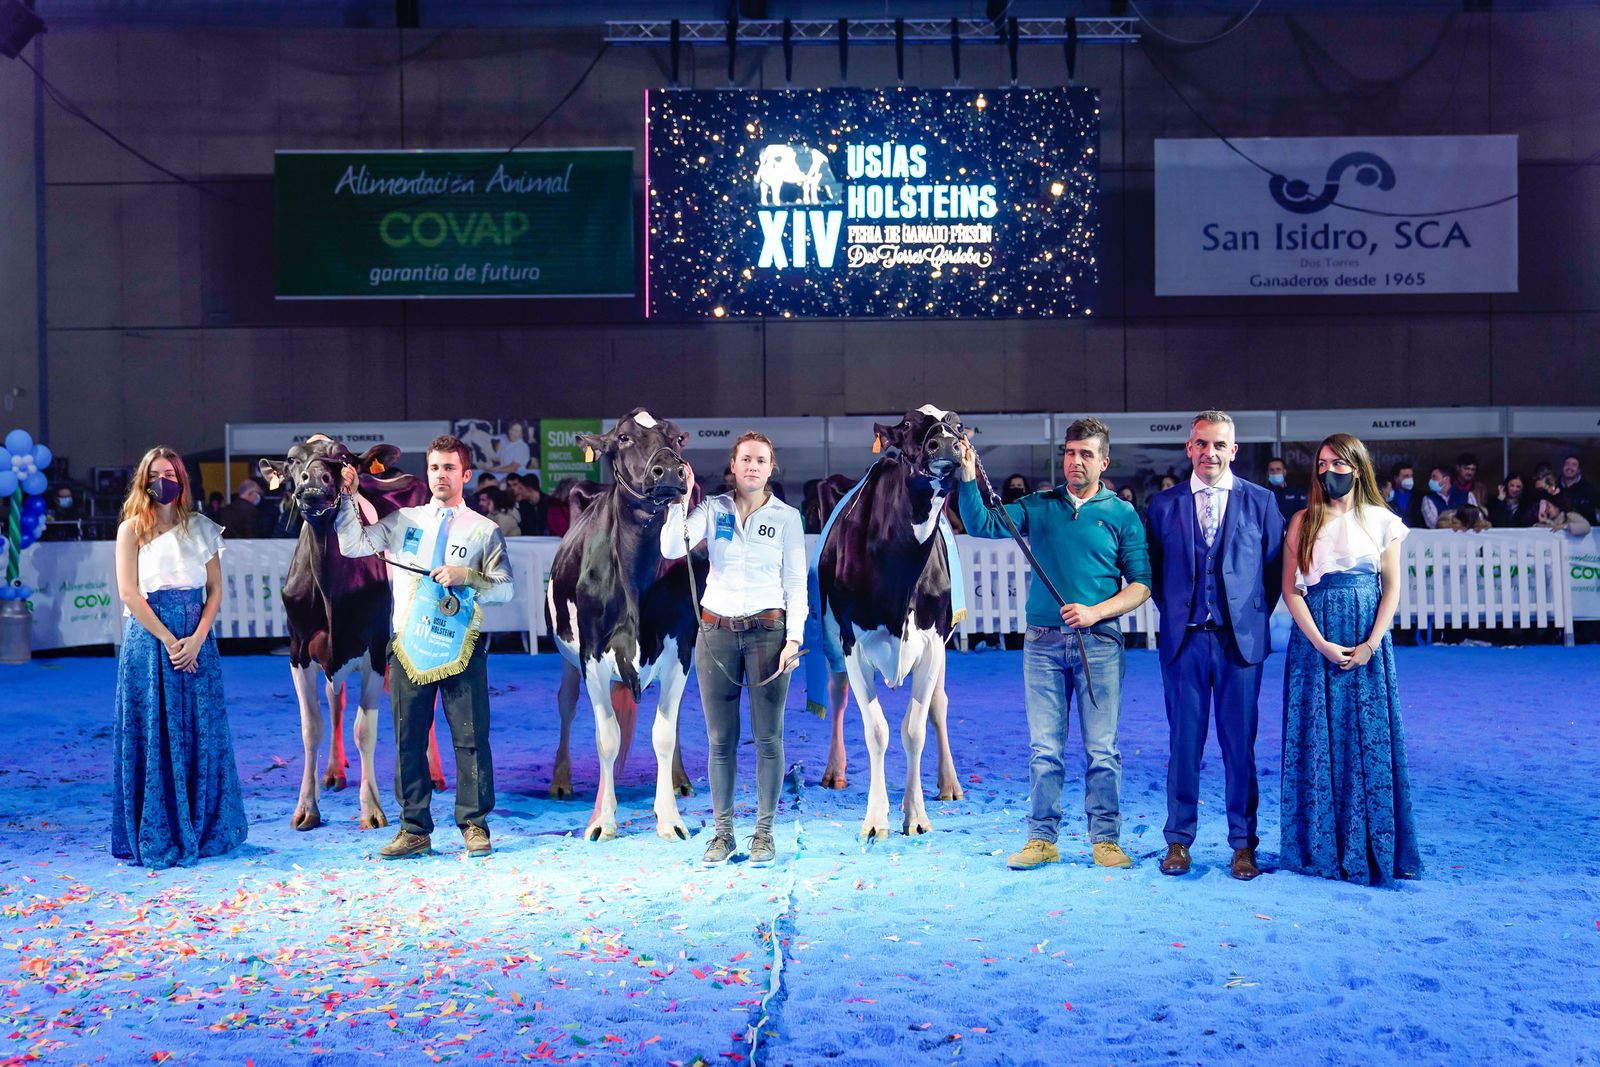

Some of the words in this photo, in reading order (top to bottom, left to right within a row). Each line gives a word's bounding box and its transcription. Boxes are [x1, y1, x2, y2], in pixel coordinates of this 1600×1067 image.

[334, 164, 475, 195] Alimentación
[485, 163, 574, 195] Animal
[847, 184, 997, 219] HOLSTEINS
[379, 211, 529, 247] COVAP
[847, 225, 883, 243] FERIA
[884, 225, 901, 243] DE
[902, 223, 948, 243] GANADO
[757, 210, 843, 268] XIV
[1202, 223, 1260, 251] San
[1275, 222, 1378, 255] Isidro,
[1394, 221, 1471, 249] SCA
[1300, 257, 1321, 268] Dos
[1326, 257, 1360, 268] Torres
[369, 264, 449, 286] garantía
[454, 263, 477, 281] de
[481, 263, 541, 284] futuro
[1250, 274, 1329, 288] Ganaderos
[1334, 273, 1376, 287] desde
[1385, 273, 1425, 286] 1965
[1150, 424, 1182, 432] COVAP
[1372, 420, 1416, 428] ALLTECH
[346, 434, 384, 443] TORRES
[548, 431, 593, 447] SOM
[758, 524, 776, 539] 80
[451, 544, 467, 558] 70
